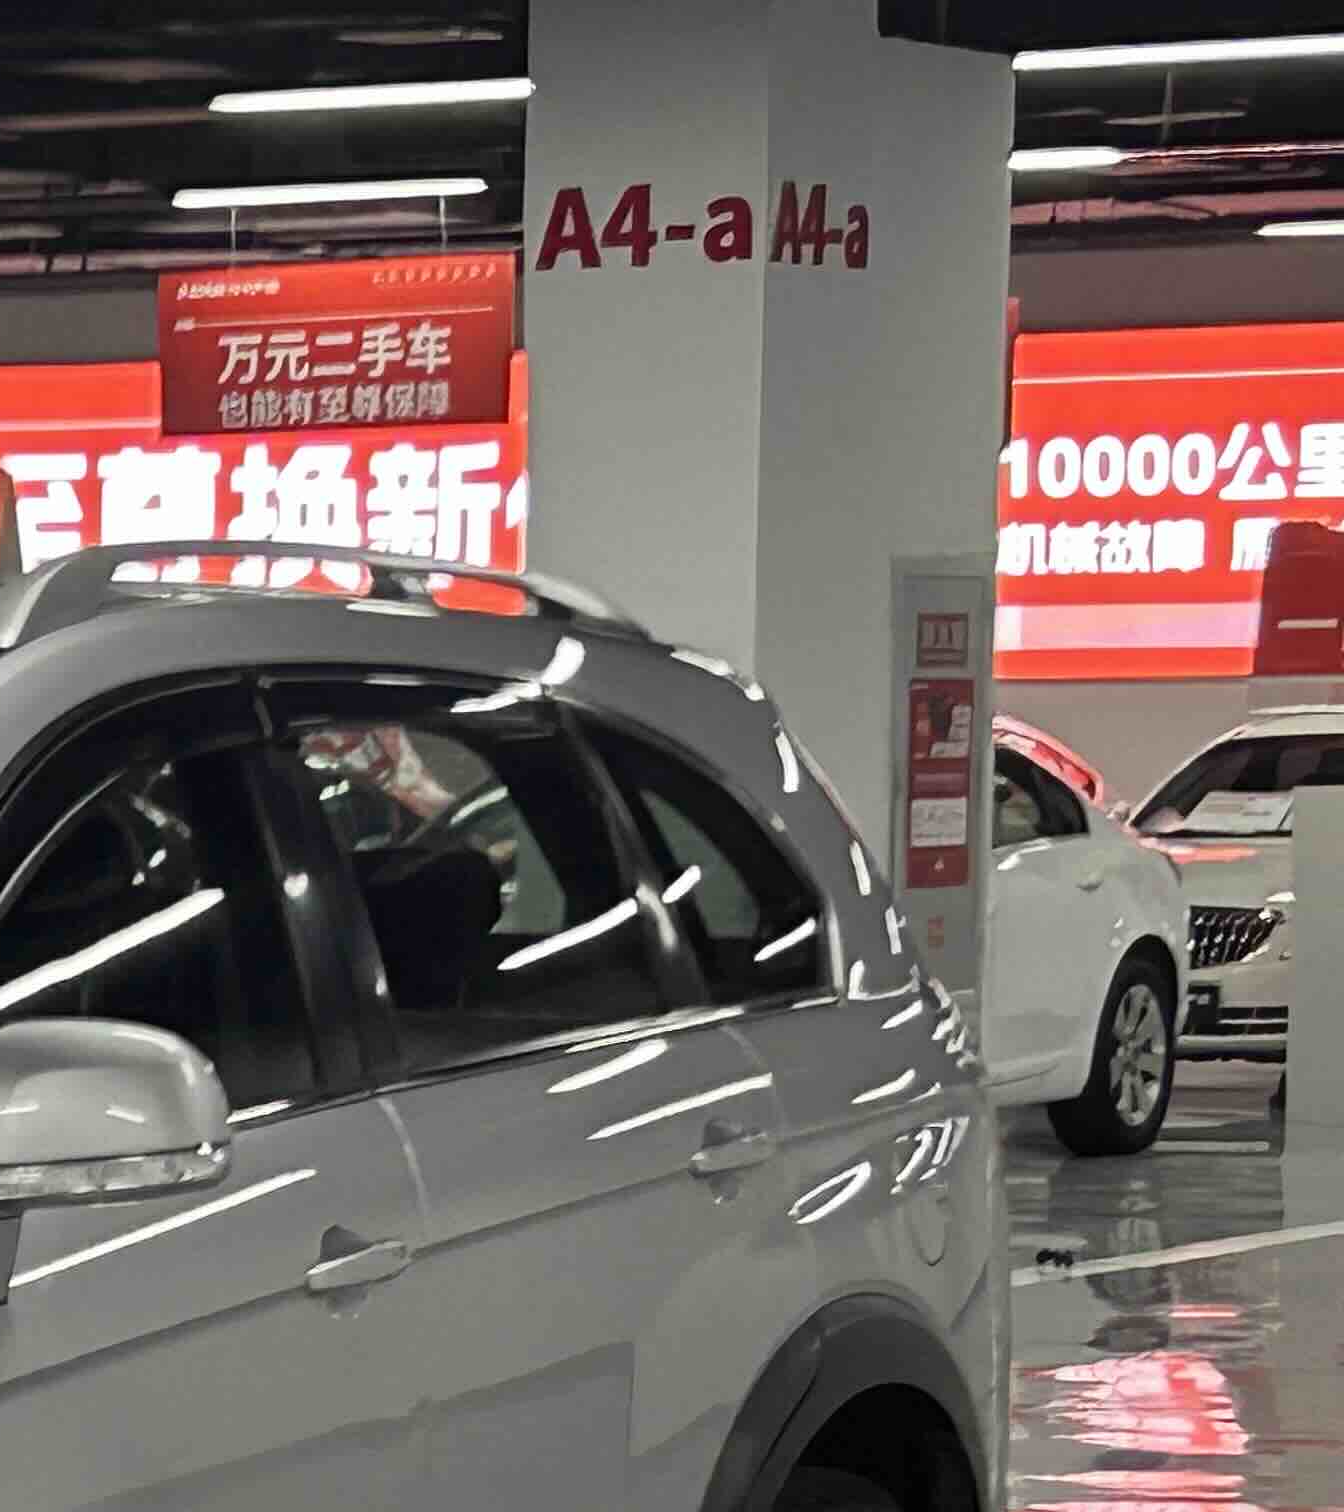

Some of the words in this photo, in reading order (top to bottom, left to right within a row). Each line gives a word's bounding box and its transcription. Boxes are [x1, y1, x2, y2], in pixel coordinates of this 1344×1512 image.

[535, 183, 753, 271] A4-a
[770, 181, 870, 270] A4-a
[217, 321, 452, 384] 万元二手车
[217, 382, 450, 429] 也能有至尊保障
